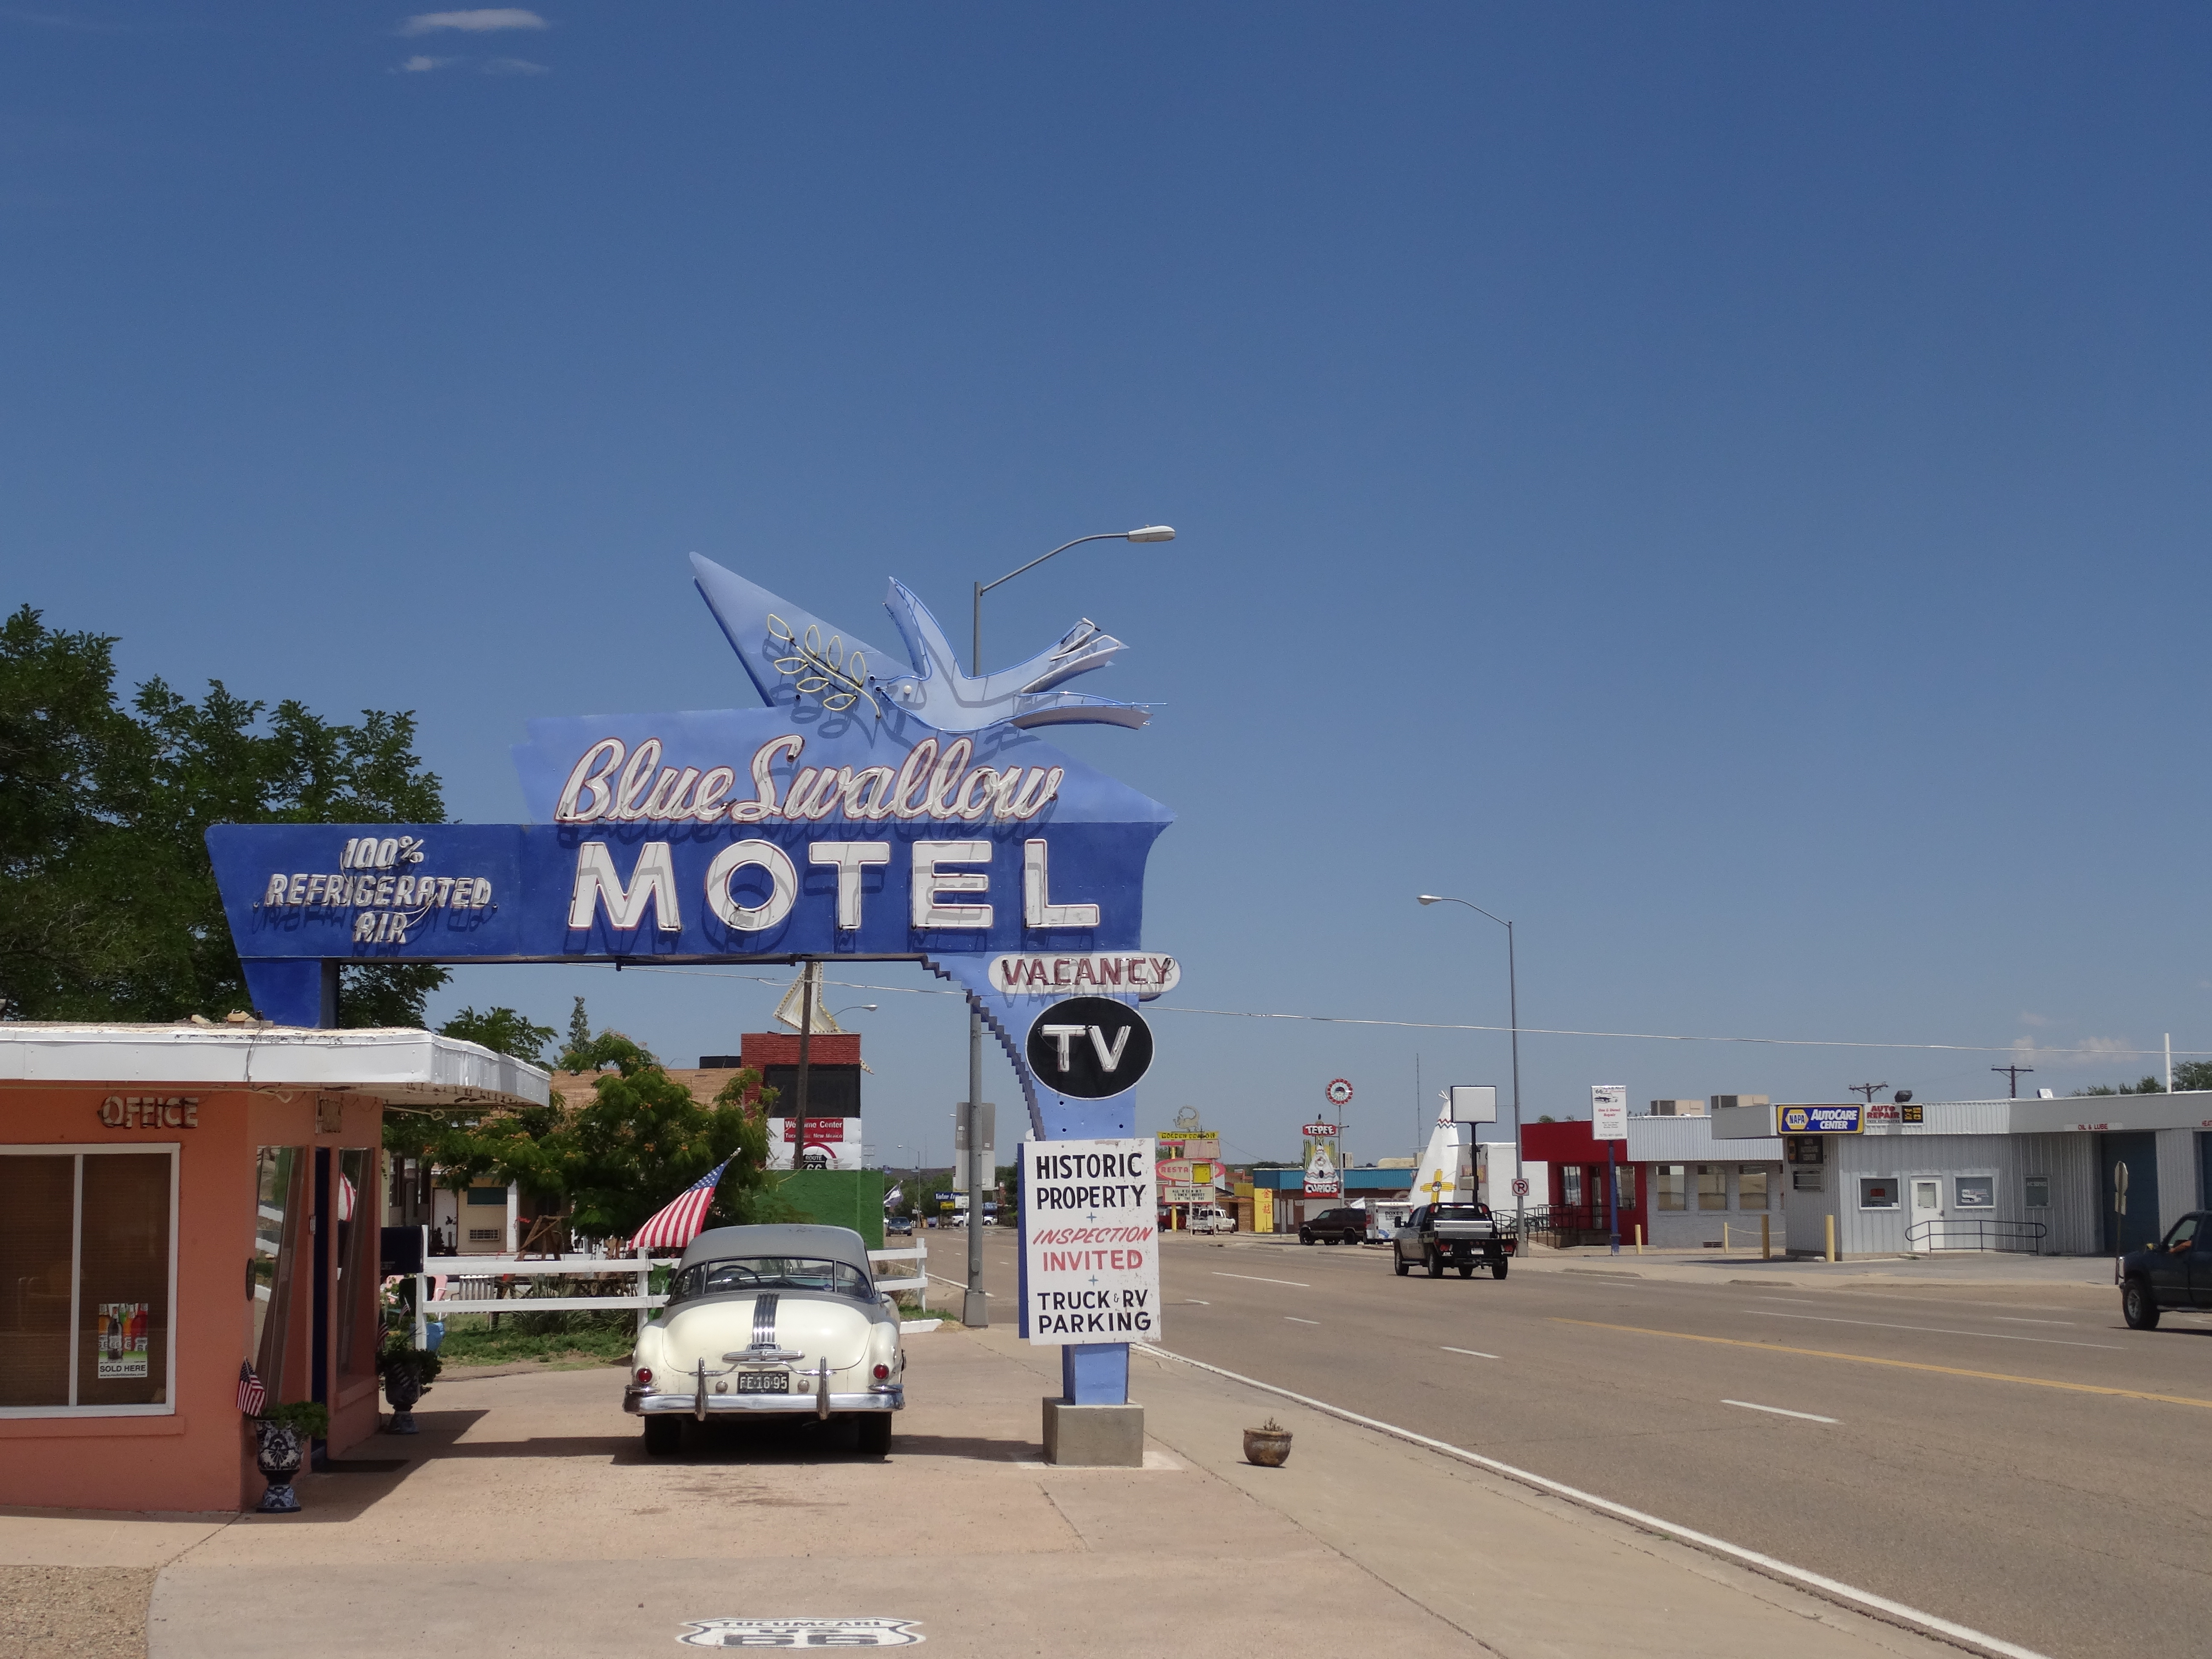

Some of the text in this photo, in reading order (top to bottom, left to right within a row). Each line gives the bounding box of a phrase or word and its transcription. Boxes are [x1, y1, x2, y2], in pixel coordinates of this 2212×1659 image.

[555, 734, 1065, 823] Blue Swallow
[343, 835, 425, 869] 100%
[264, 873, 492, 908] REFRIGERATED
[568, 838, 1100, 931] MOTEL
[353, 912, 407, 944] AIR
[1002, 957, 1170, 985] VACANCY
[1042, 1024, 1132, 1072] TV
[102, 1096, 199, 1129] OFFICE
[1789, 1114, 1805, 1124] NAPA
[820, 1121, 842, 1129] Center
[1305, 1125, 1334, 1135] TEPEE
[1819, 1121, 1848, 1129] CENTER
[1036, 1153, 1142, 1179] HISTORIC
[1037, 1184, 1146, 1209] PROPERTY
[1305, 1184, 1337, 1193] CURIOS
[1033, 1226, 1153, 1245] INSPECTION
[1043, 1249, 1143, 1272] INVITED
[1037, 1289, 1148, 1310] TRUCK & RV
[1039, 1311, 1151, 1334] PARKING
[724, 1634, 878, 1646] 66
